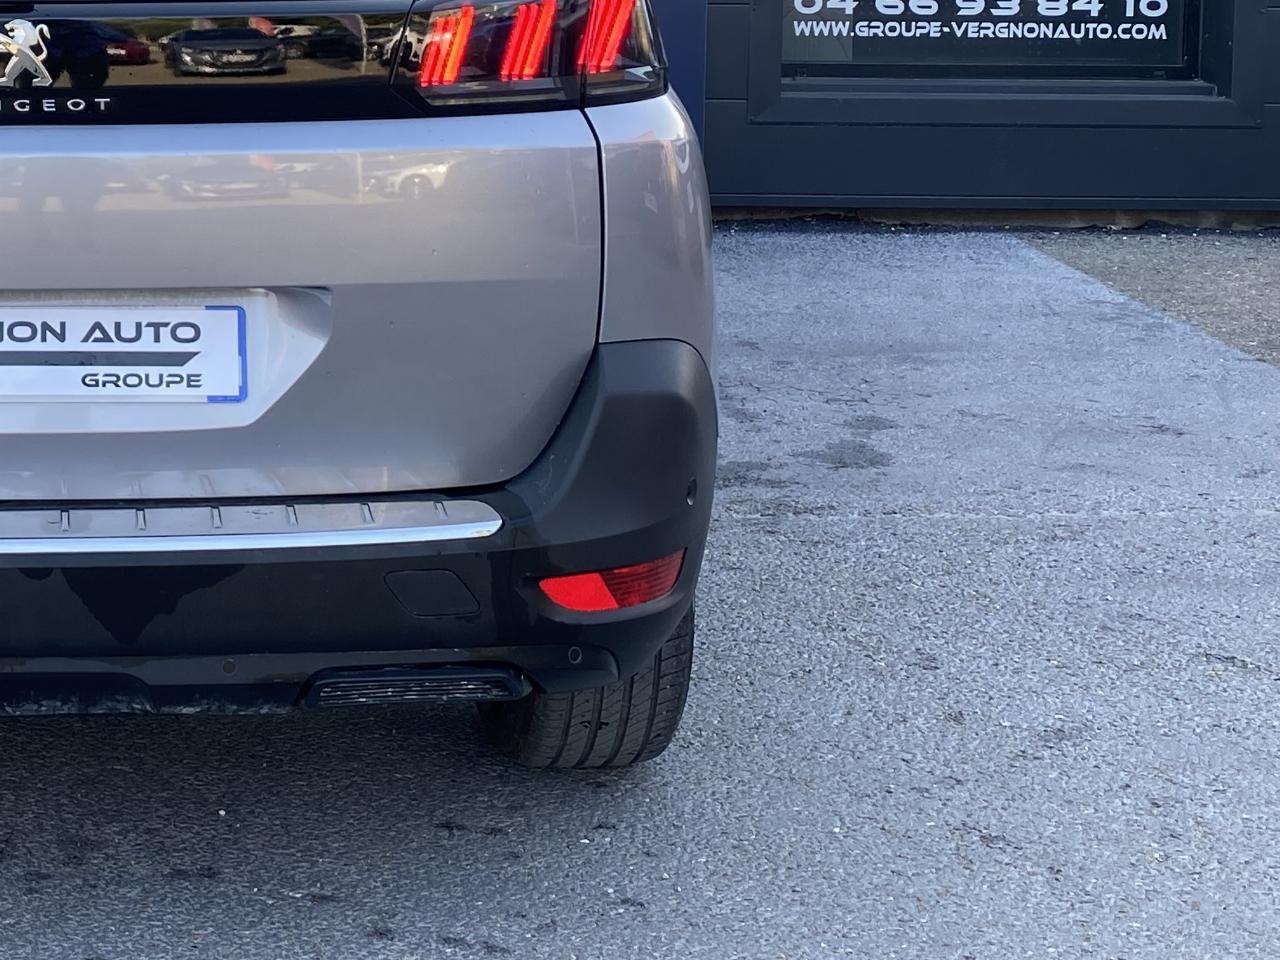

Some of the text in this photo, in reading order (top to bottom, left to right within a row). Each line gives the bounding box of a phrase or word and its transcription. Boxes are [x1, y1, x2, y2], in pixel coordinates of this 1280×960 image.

[793, 20, 1168, 41] WWW.GROUPE-VERGNONAUTO.COM
[80, 320, 202, 344] AUTO
[81, 373, 203, 389] GROUPE
